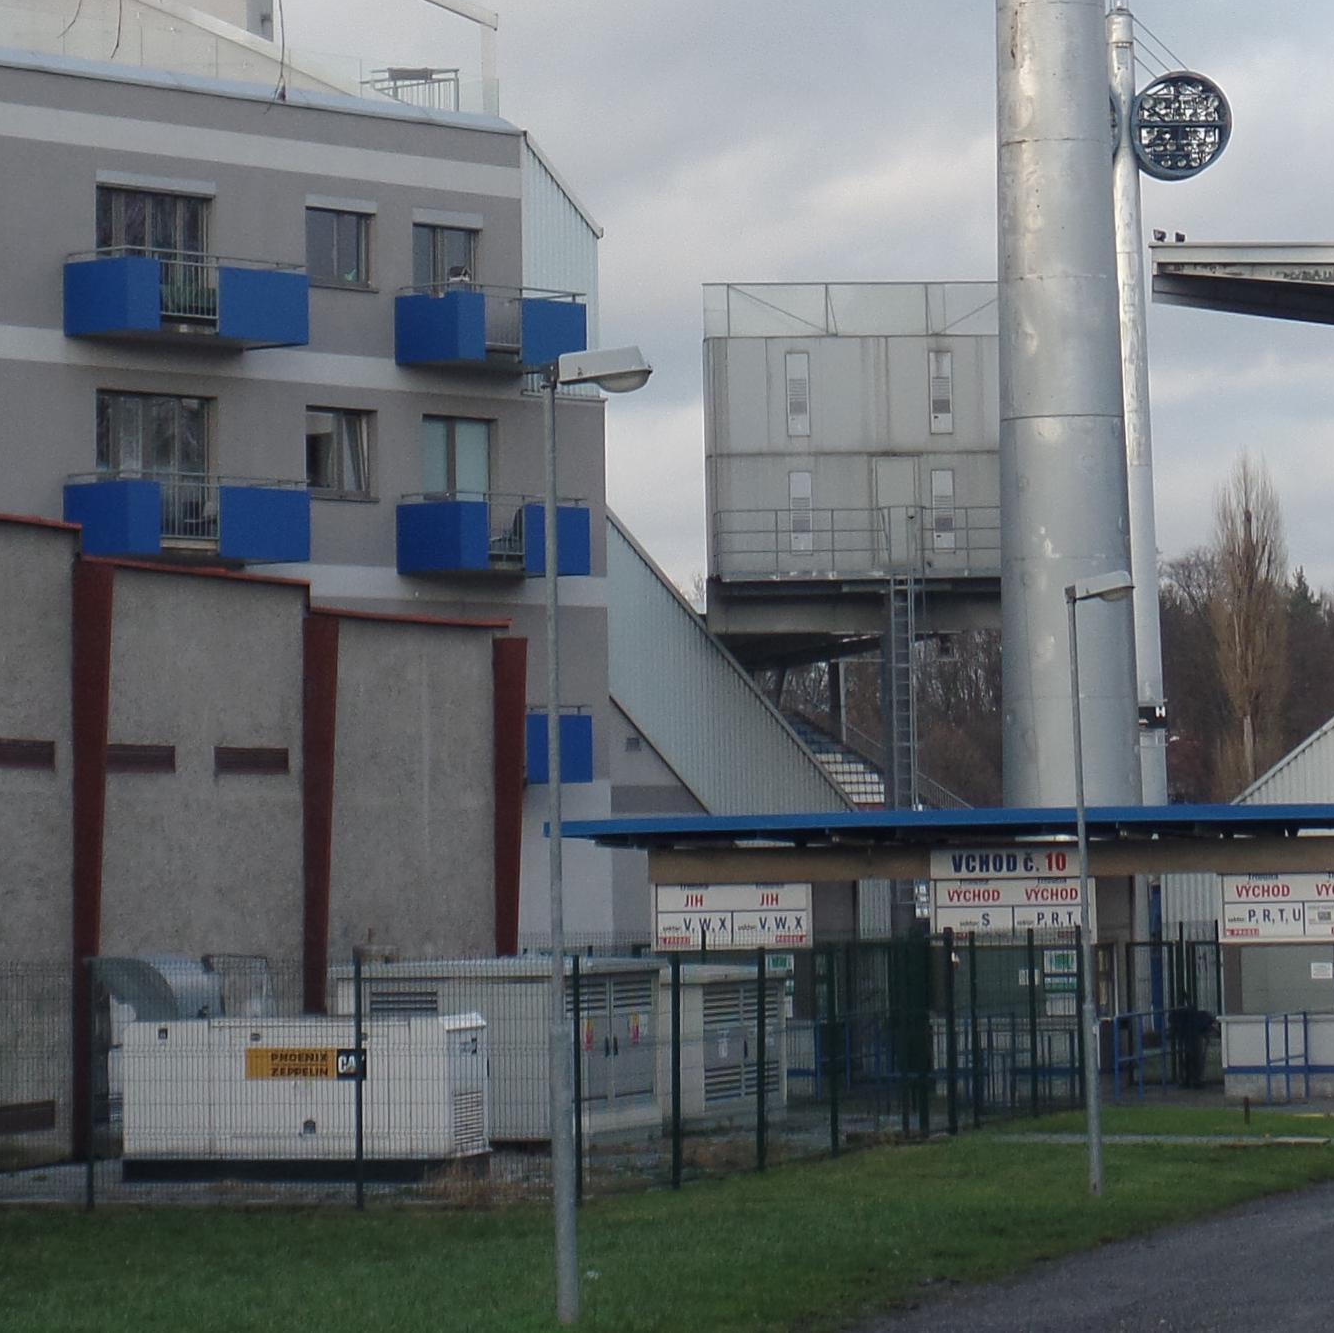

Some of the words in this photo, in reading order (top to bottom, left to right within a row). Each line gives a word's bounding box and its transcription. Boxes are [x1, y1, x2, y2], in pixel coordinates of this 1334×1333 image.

[952, 854, 1017, 873] VCHOD
[1045, 852, 1067, 871] 10
[684, 894, 703, 907] JIH
[760, 893, 779, 906] JIH
[981, 912, 991, 927] S
[1292, 908, 1301, 922] U
[271, 1053, 328, 1062] PHOENIX
[271, 1067, 328, 1077] ZEPPELIN
